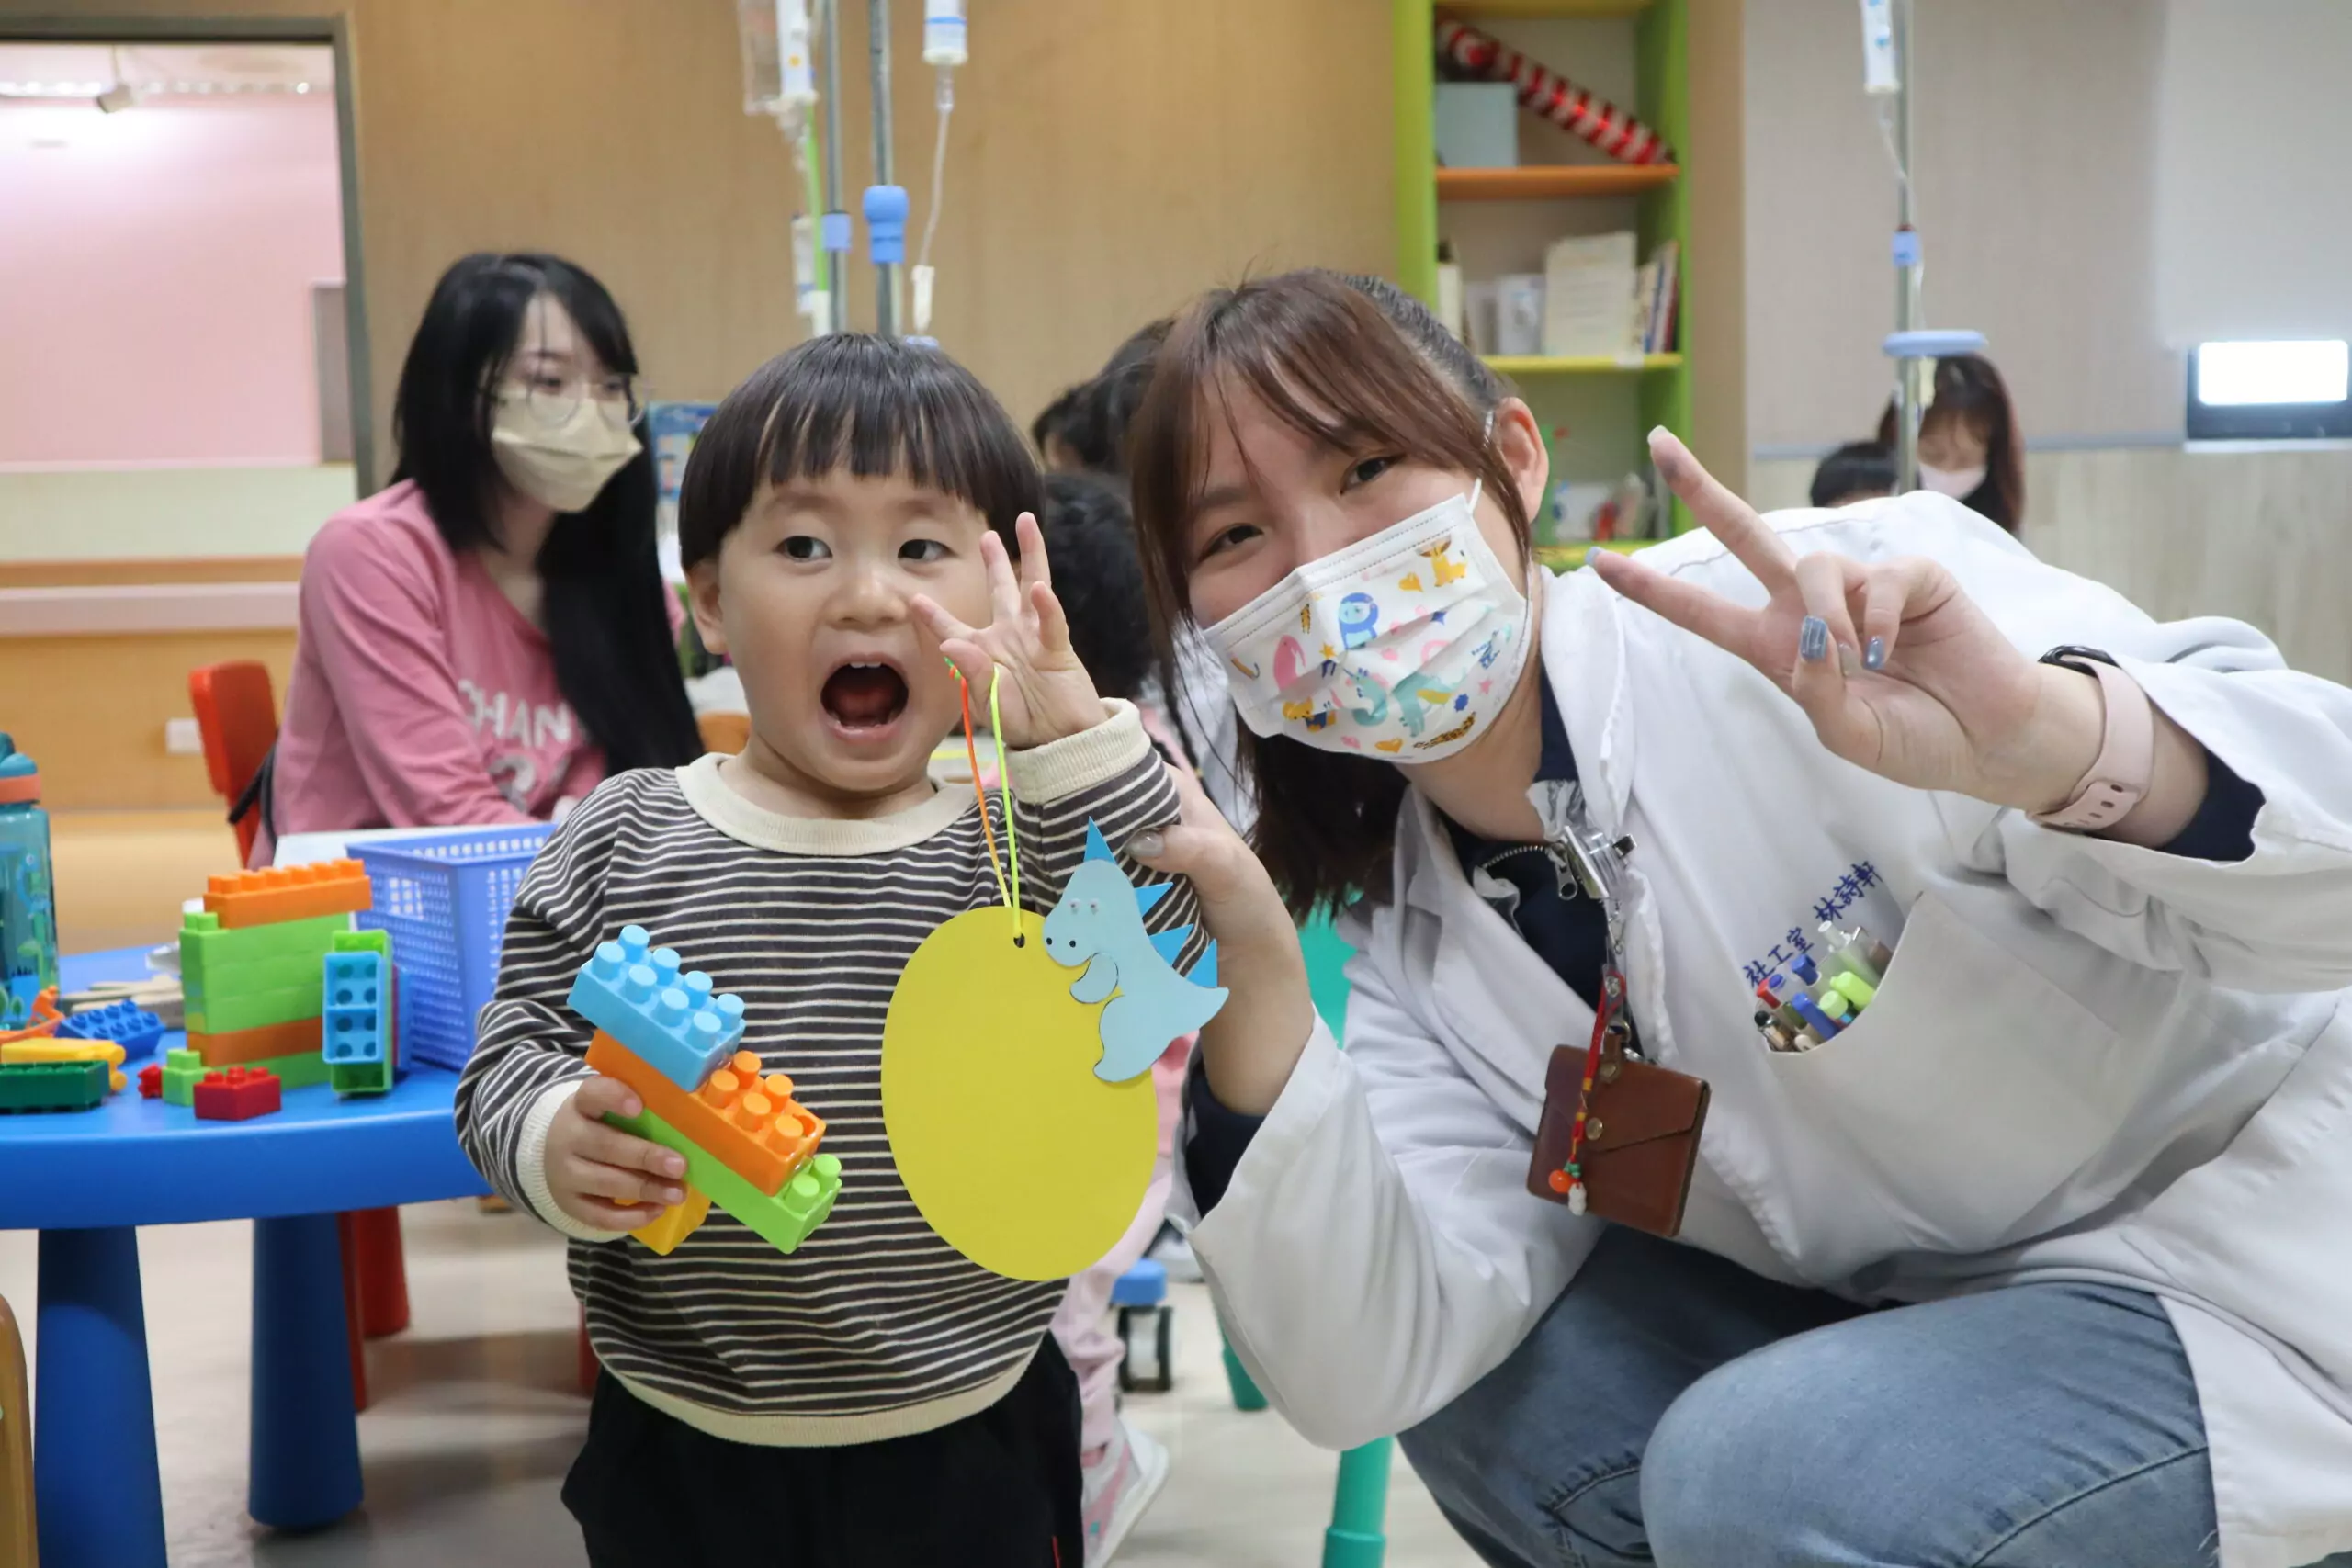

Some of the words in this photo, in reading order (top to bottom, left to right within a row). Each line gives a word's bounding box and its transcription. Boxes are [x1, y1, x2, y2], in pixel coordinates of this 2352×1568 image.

[458, 679, 591, 750] HAN
[1743, 927, 1815, 987] 社工室
